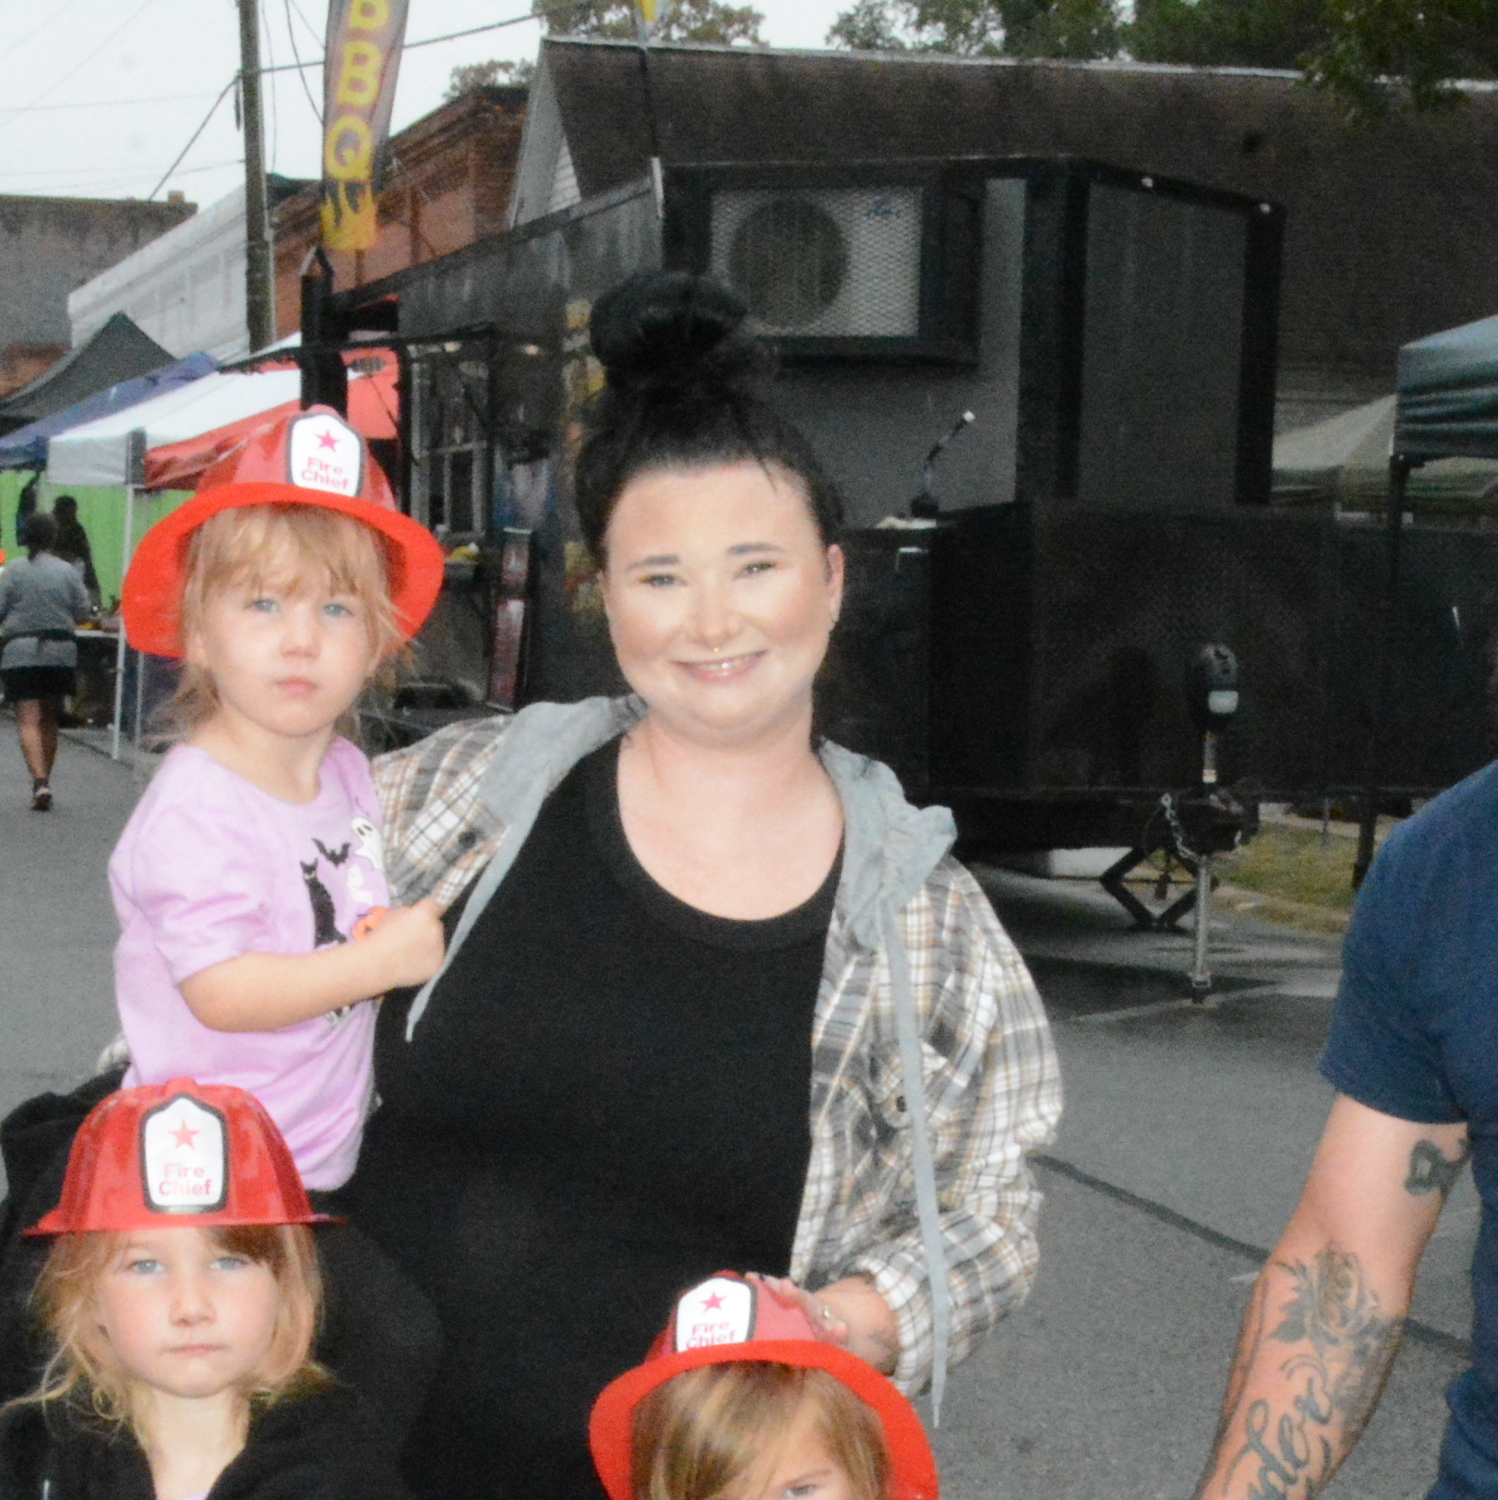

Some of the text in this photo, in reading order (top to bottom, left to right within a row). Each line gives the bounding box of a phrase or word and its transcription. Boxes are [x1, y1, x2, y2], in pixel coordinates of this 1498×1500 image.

[308, 456, 343, 475] Fire
[301, 468, 349, 490] Chief
[163, 1162, 205, 1179] Fire
[158, 1178, 213, 1196] Chief
[692, 1321, 730, 1336] Fire
[686, 1330, 737, 1349] Chief
